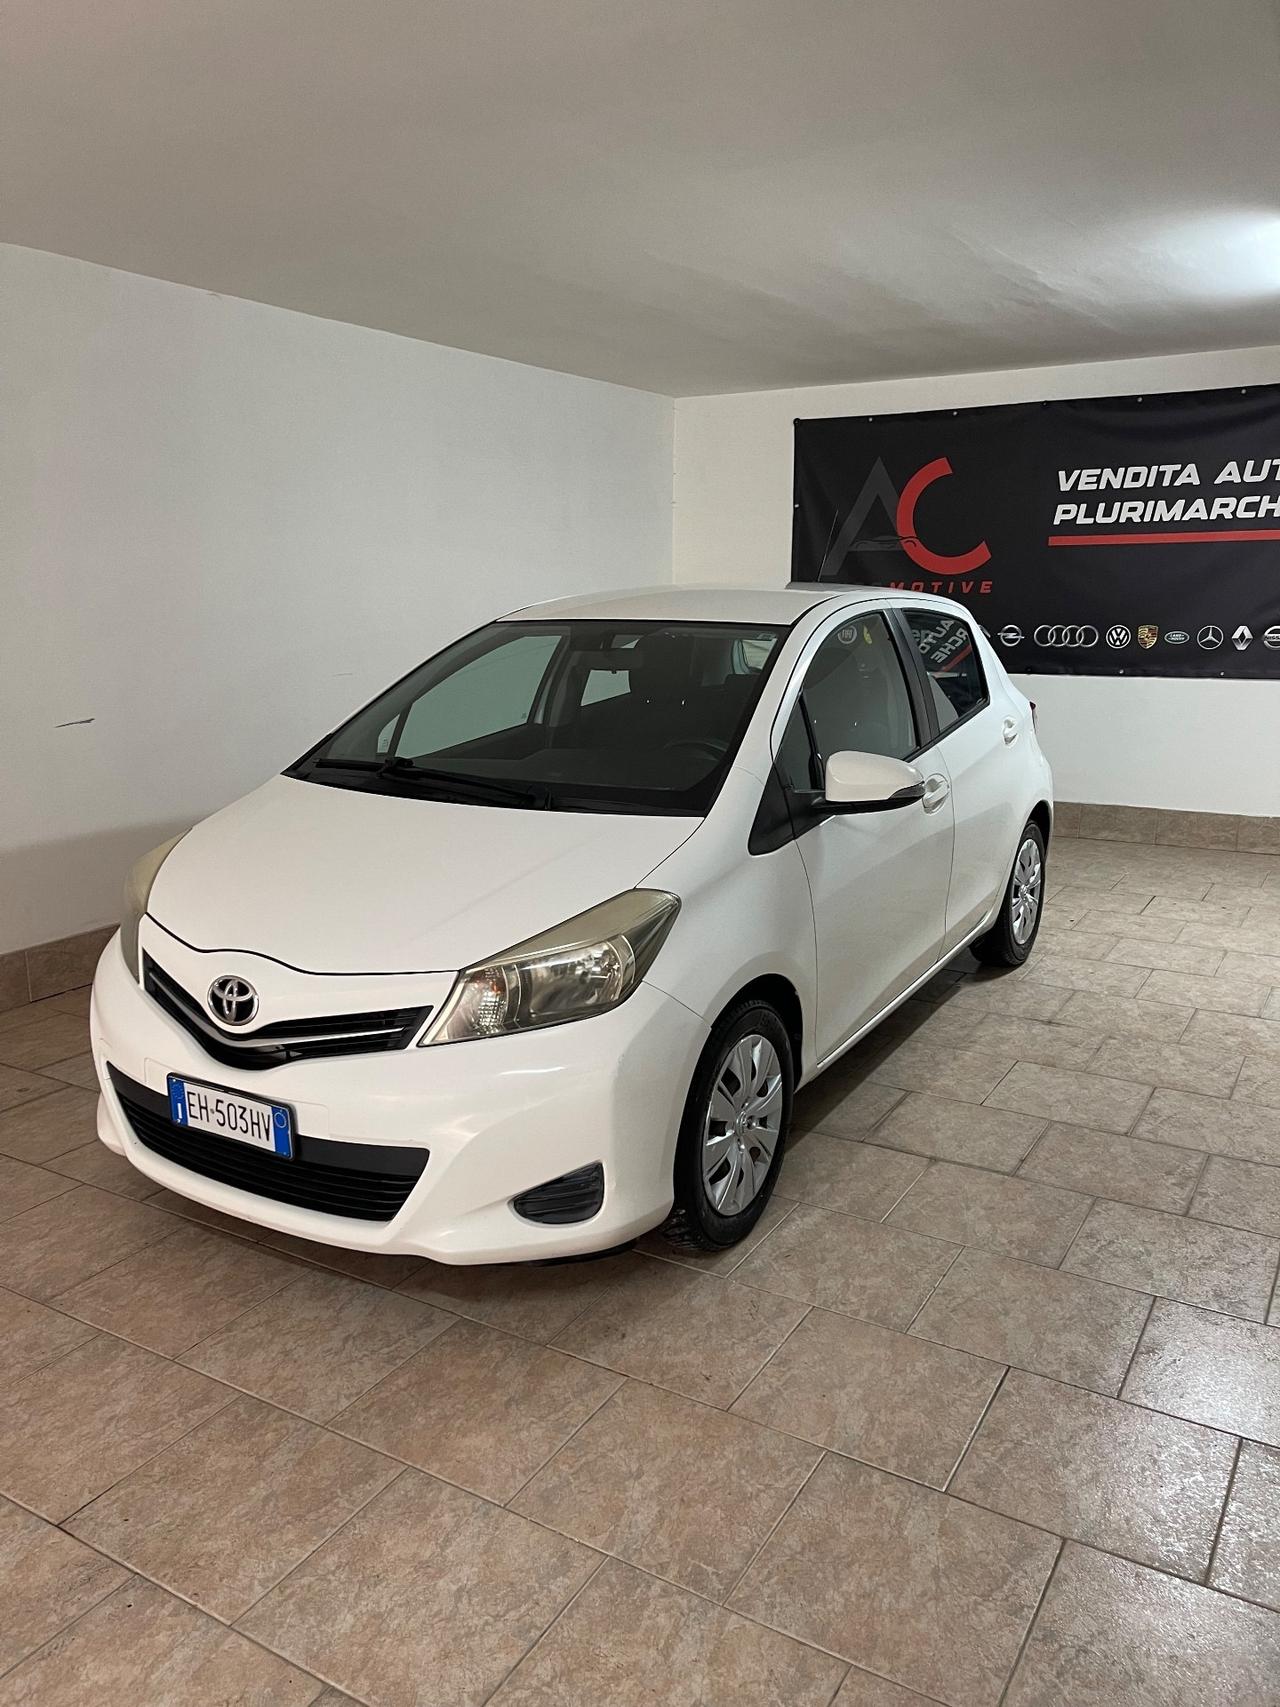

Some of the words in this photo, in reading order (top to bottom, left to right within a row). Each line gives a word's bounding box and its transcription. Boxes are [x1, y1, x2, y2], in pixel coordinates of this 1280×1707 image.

[1058, 463, 1201, 492] VENDITA
[1053, 495, 1280, 526] PLURIMARCH
[870, 580, 993, 594] MOTIVE
